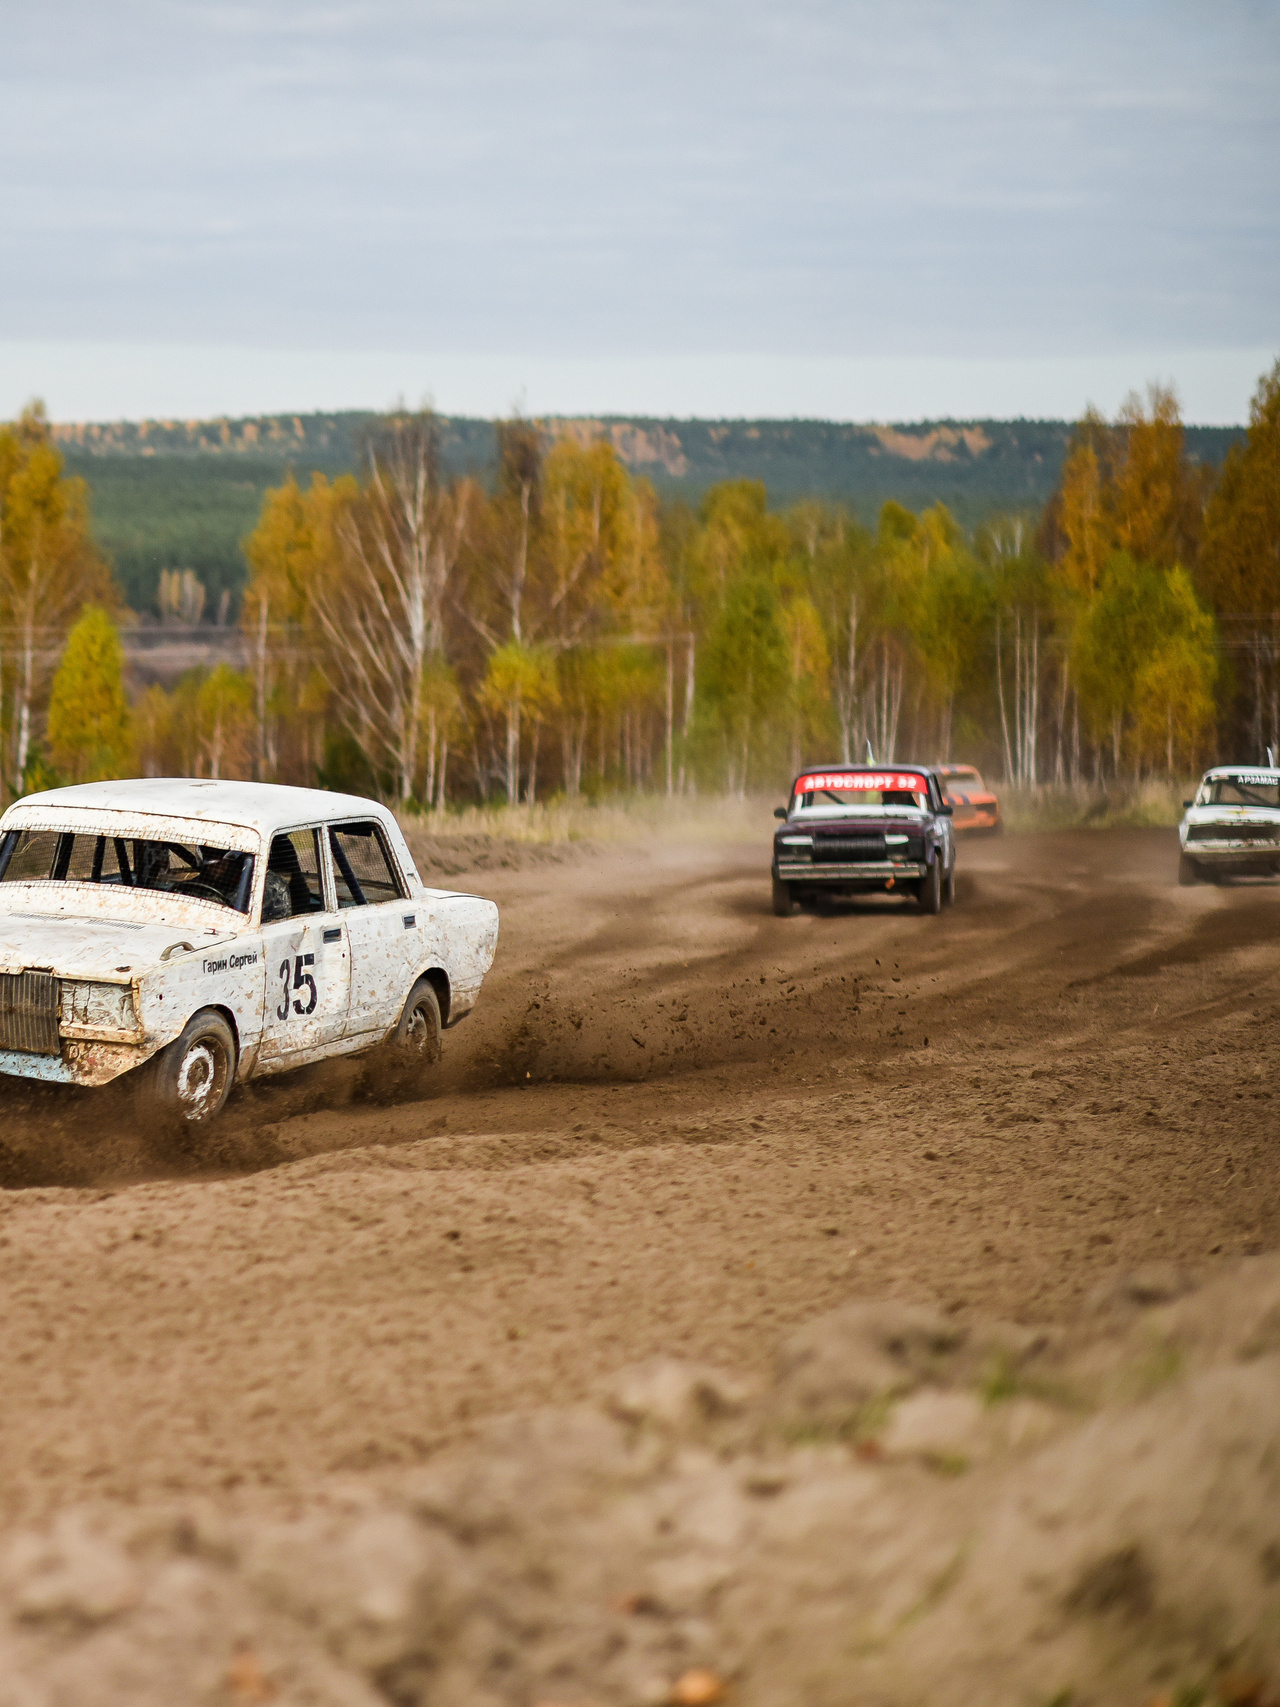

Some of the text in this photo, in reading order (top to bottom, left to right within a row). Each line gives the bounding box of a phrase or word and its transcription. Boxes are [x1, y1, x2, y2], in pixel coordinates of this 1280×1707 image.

[202, 951, 258, 974] Гарин Сергей
[276, 953, 317, 1020] 35
